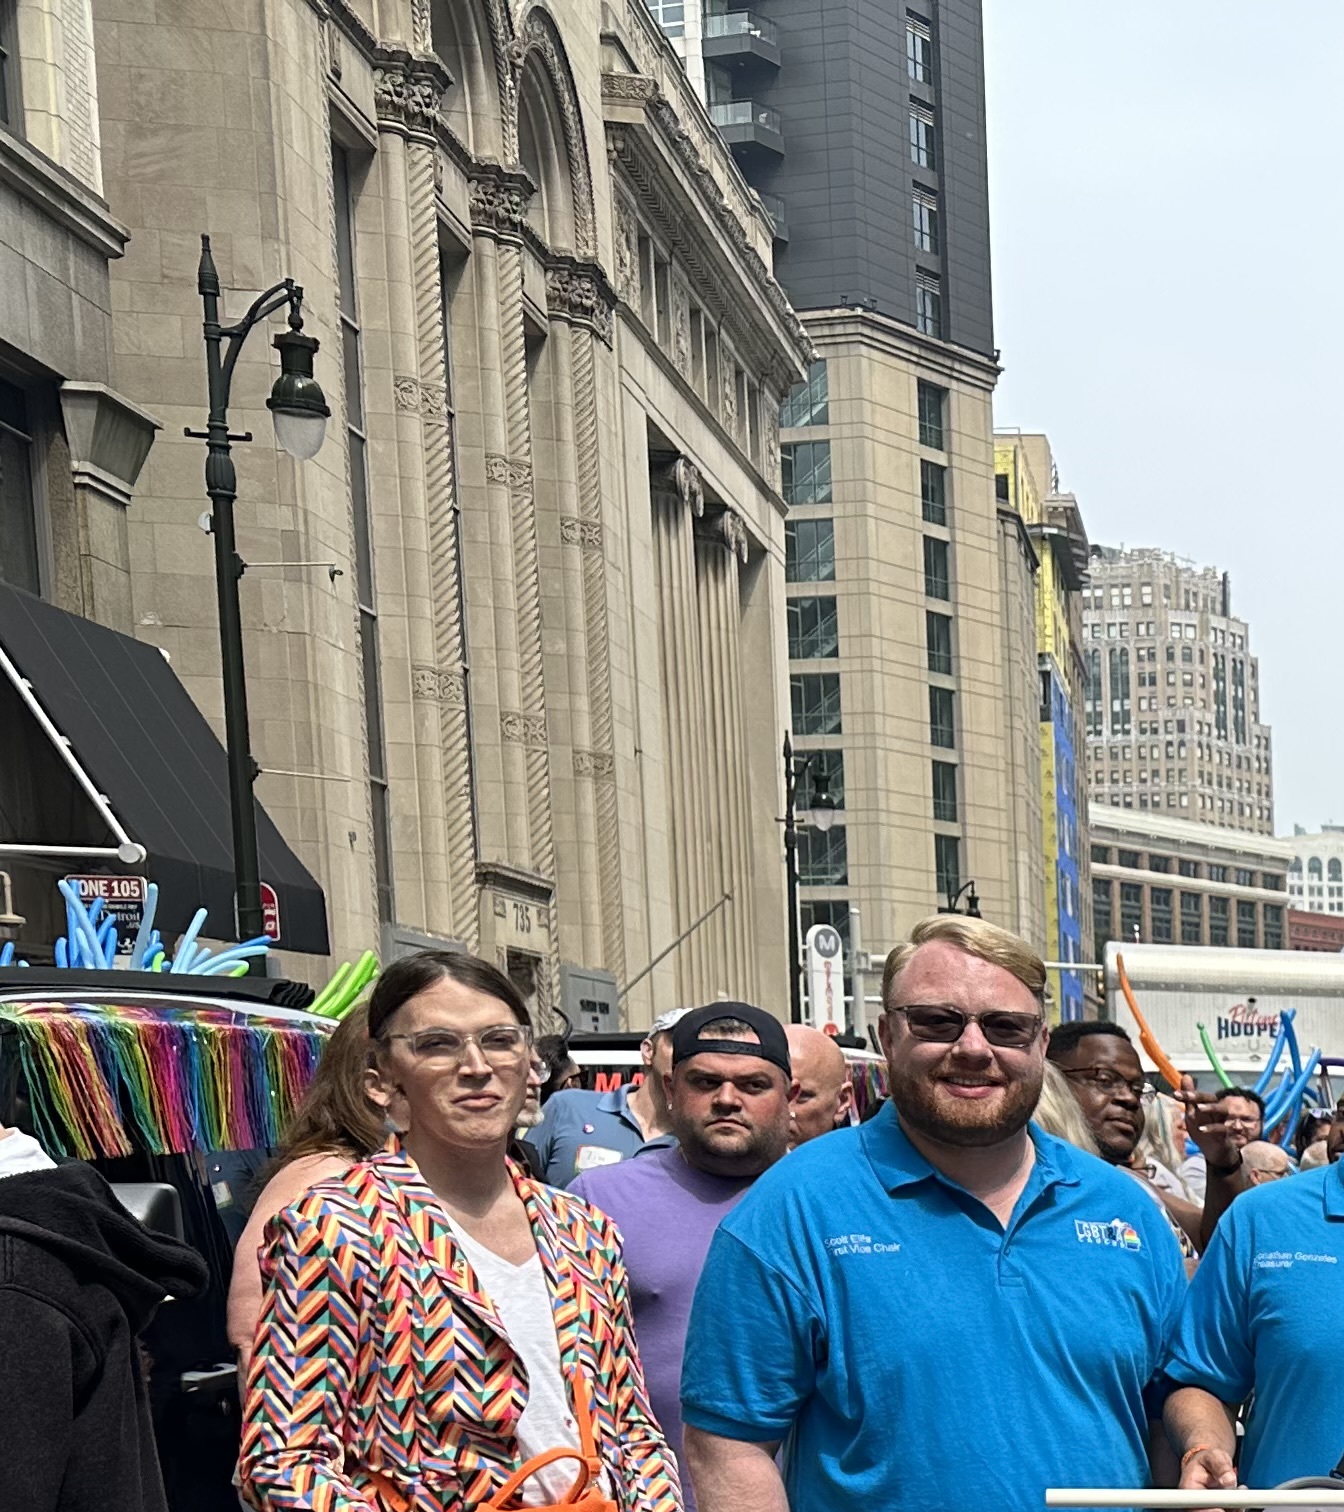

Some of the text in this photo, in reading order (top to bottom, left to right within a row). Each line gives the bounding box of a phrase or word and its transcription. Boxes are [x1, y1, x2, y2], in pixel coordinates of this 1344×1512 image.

[78, 880, 140, 897] ONE 105
[513, 902, 531, 934] 735
[818, 934, 836, 952] M
[1217, 1016, 1280, 1040] HOOPE
